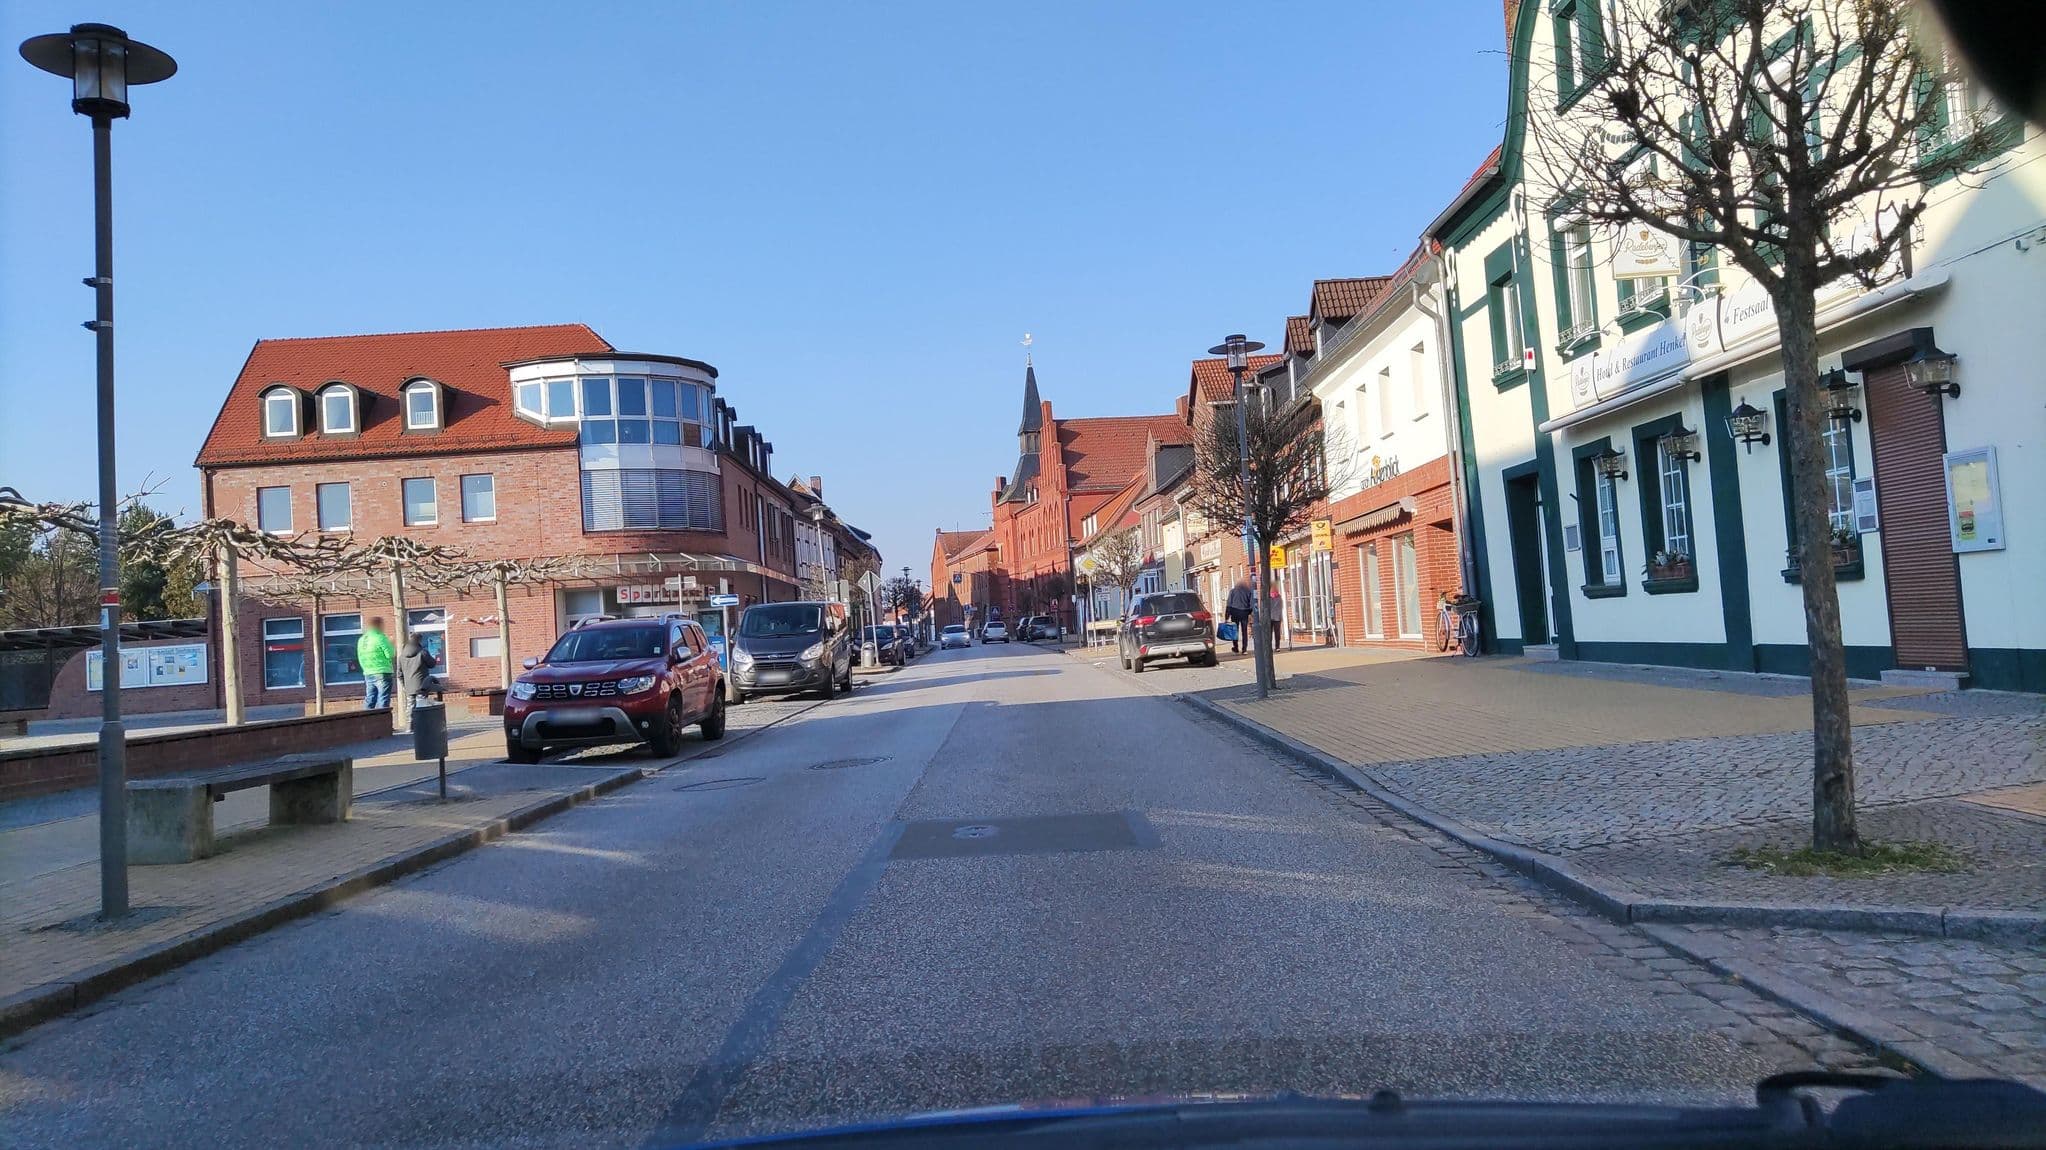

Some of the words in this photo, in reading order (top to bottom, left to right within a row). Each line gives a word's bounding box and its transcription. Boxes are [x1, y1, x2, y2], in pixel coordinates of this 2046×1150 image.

[1733, 294, 1769, 324] Festsaal
[1596, 362, 1613, 381] Hotel
[1622, 348, 1658, 371] Restaurant
